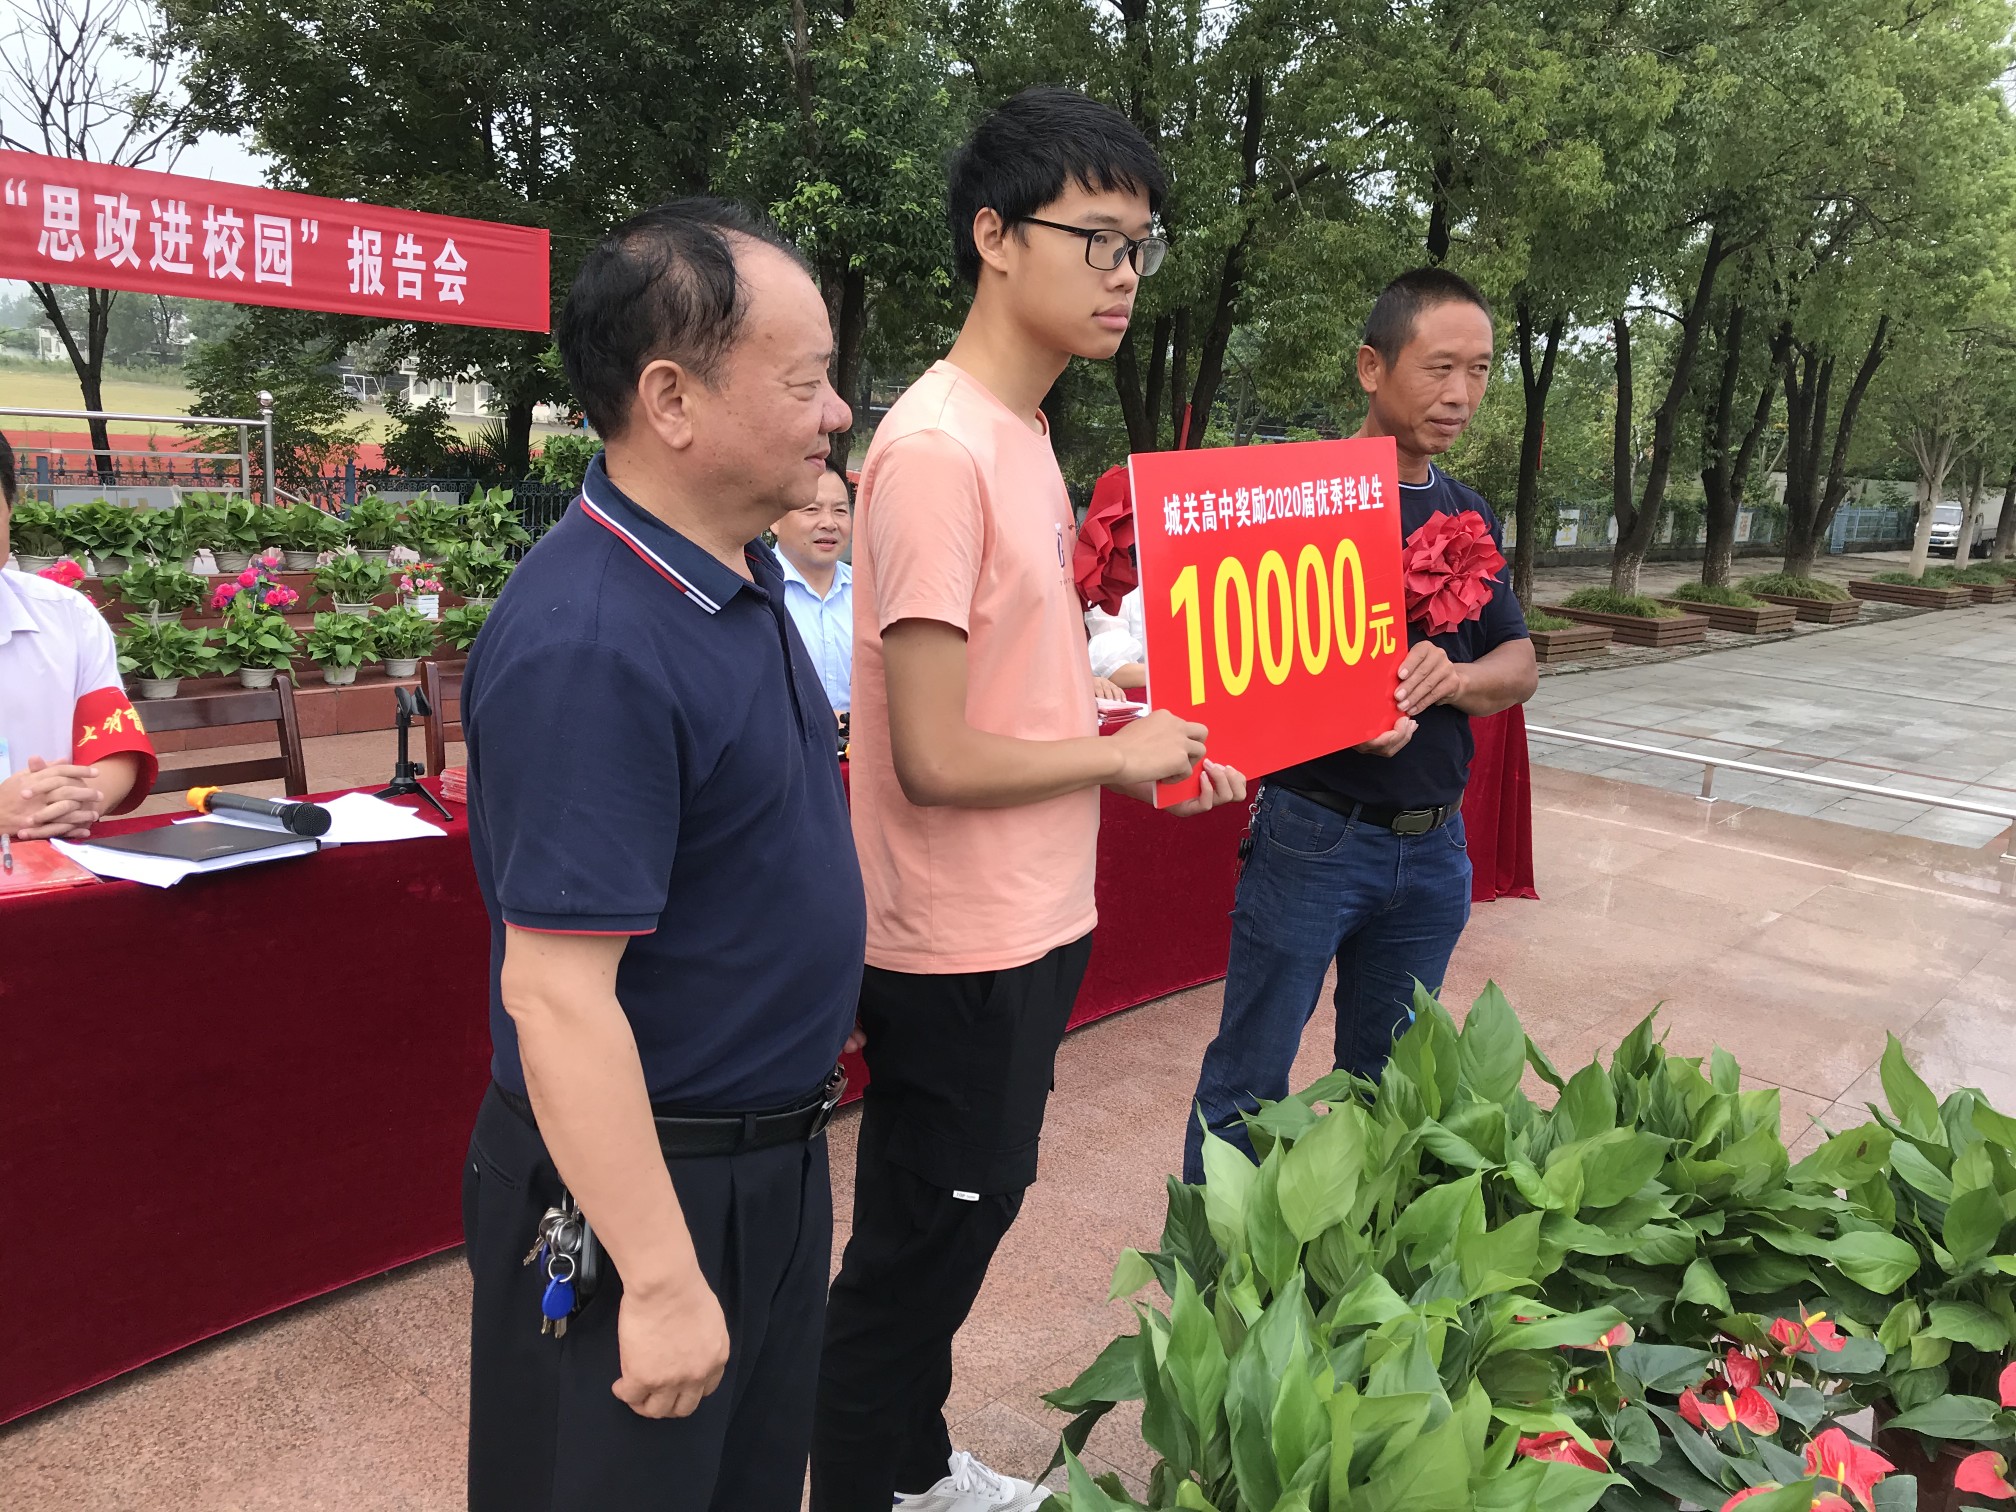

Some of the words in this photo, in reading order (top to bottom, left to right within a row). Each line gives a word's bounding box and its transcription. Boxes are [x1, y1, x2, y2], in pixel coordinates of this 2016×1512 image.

[346, 225, 469, 305] 报告会
[1163, 473, 1385, 536] 城关高中奖励2020届优秀毕业生
